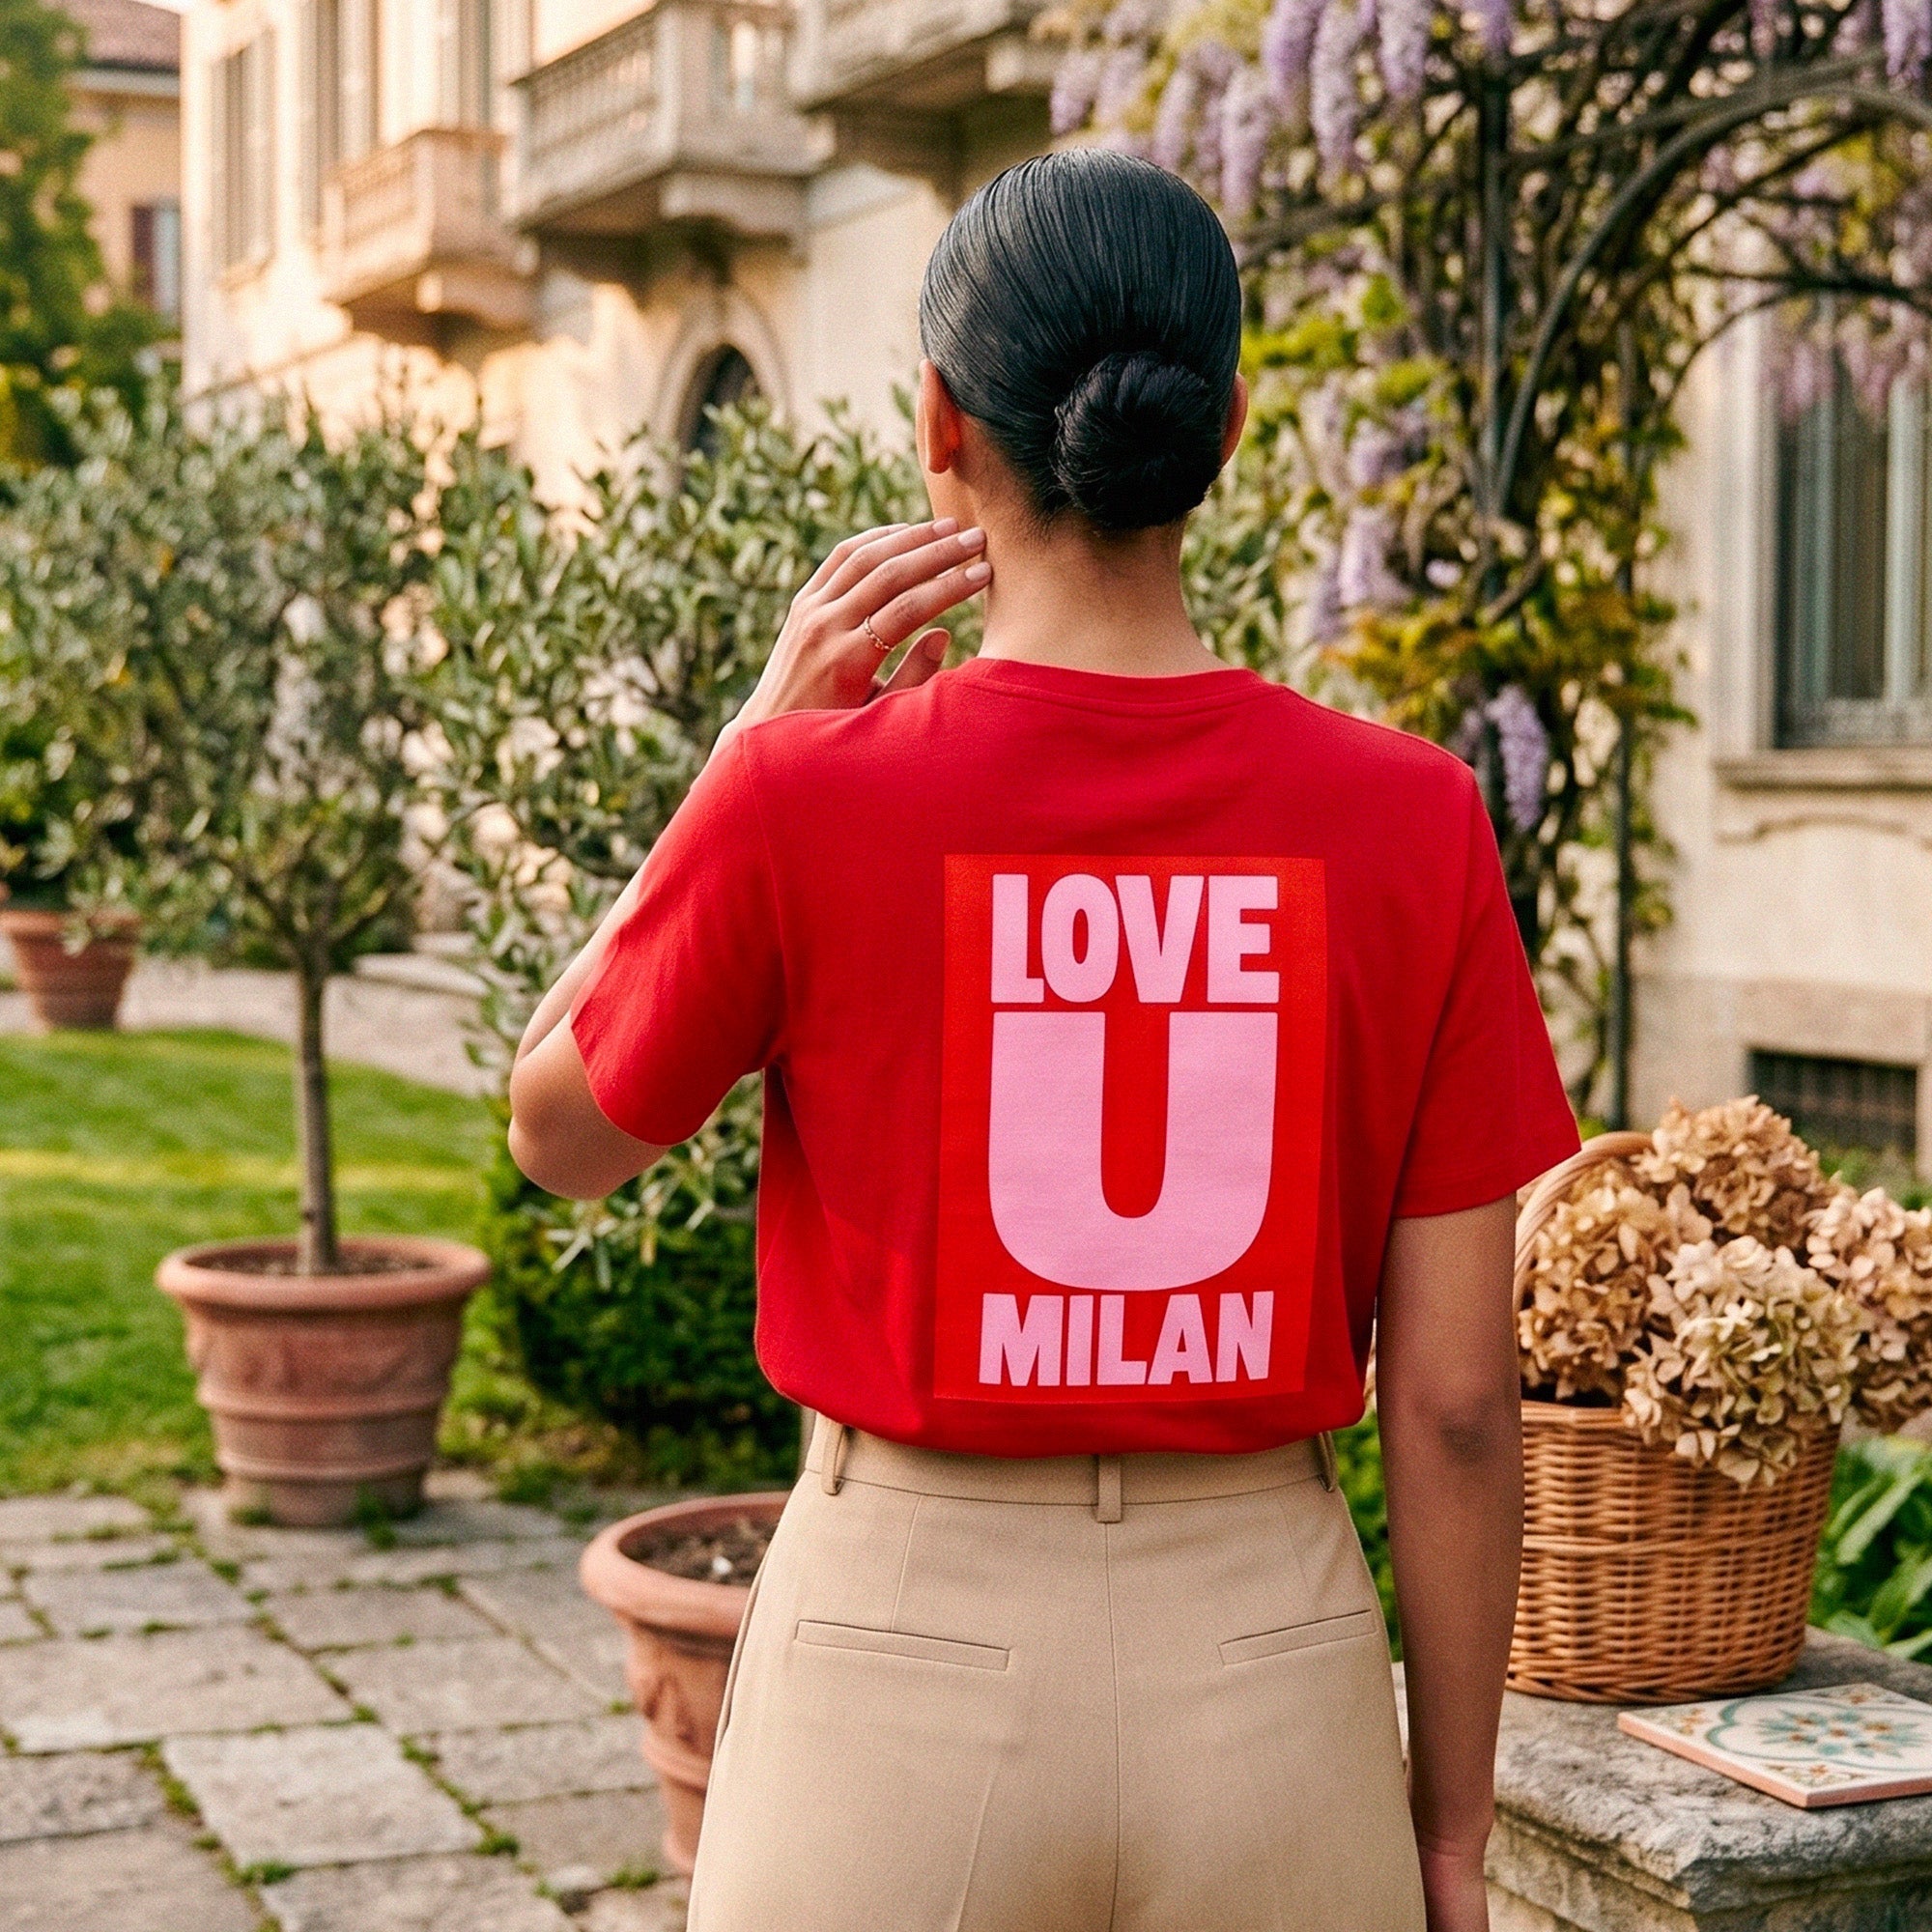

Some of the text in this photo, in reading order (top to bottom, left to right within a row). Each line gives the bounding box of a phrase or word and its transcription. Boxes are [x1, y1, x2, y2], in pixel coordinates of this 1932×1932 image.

[990, 873, 1280, 1004] LOVE
[988, 1011, 1278, 1292] U
[979, 1291, 1274, 1386] MILAN
